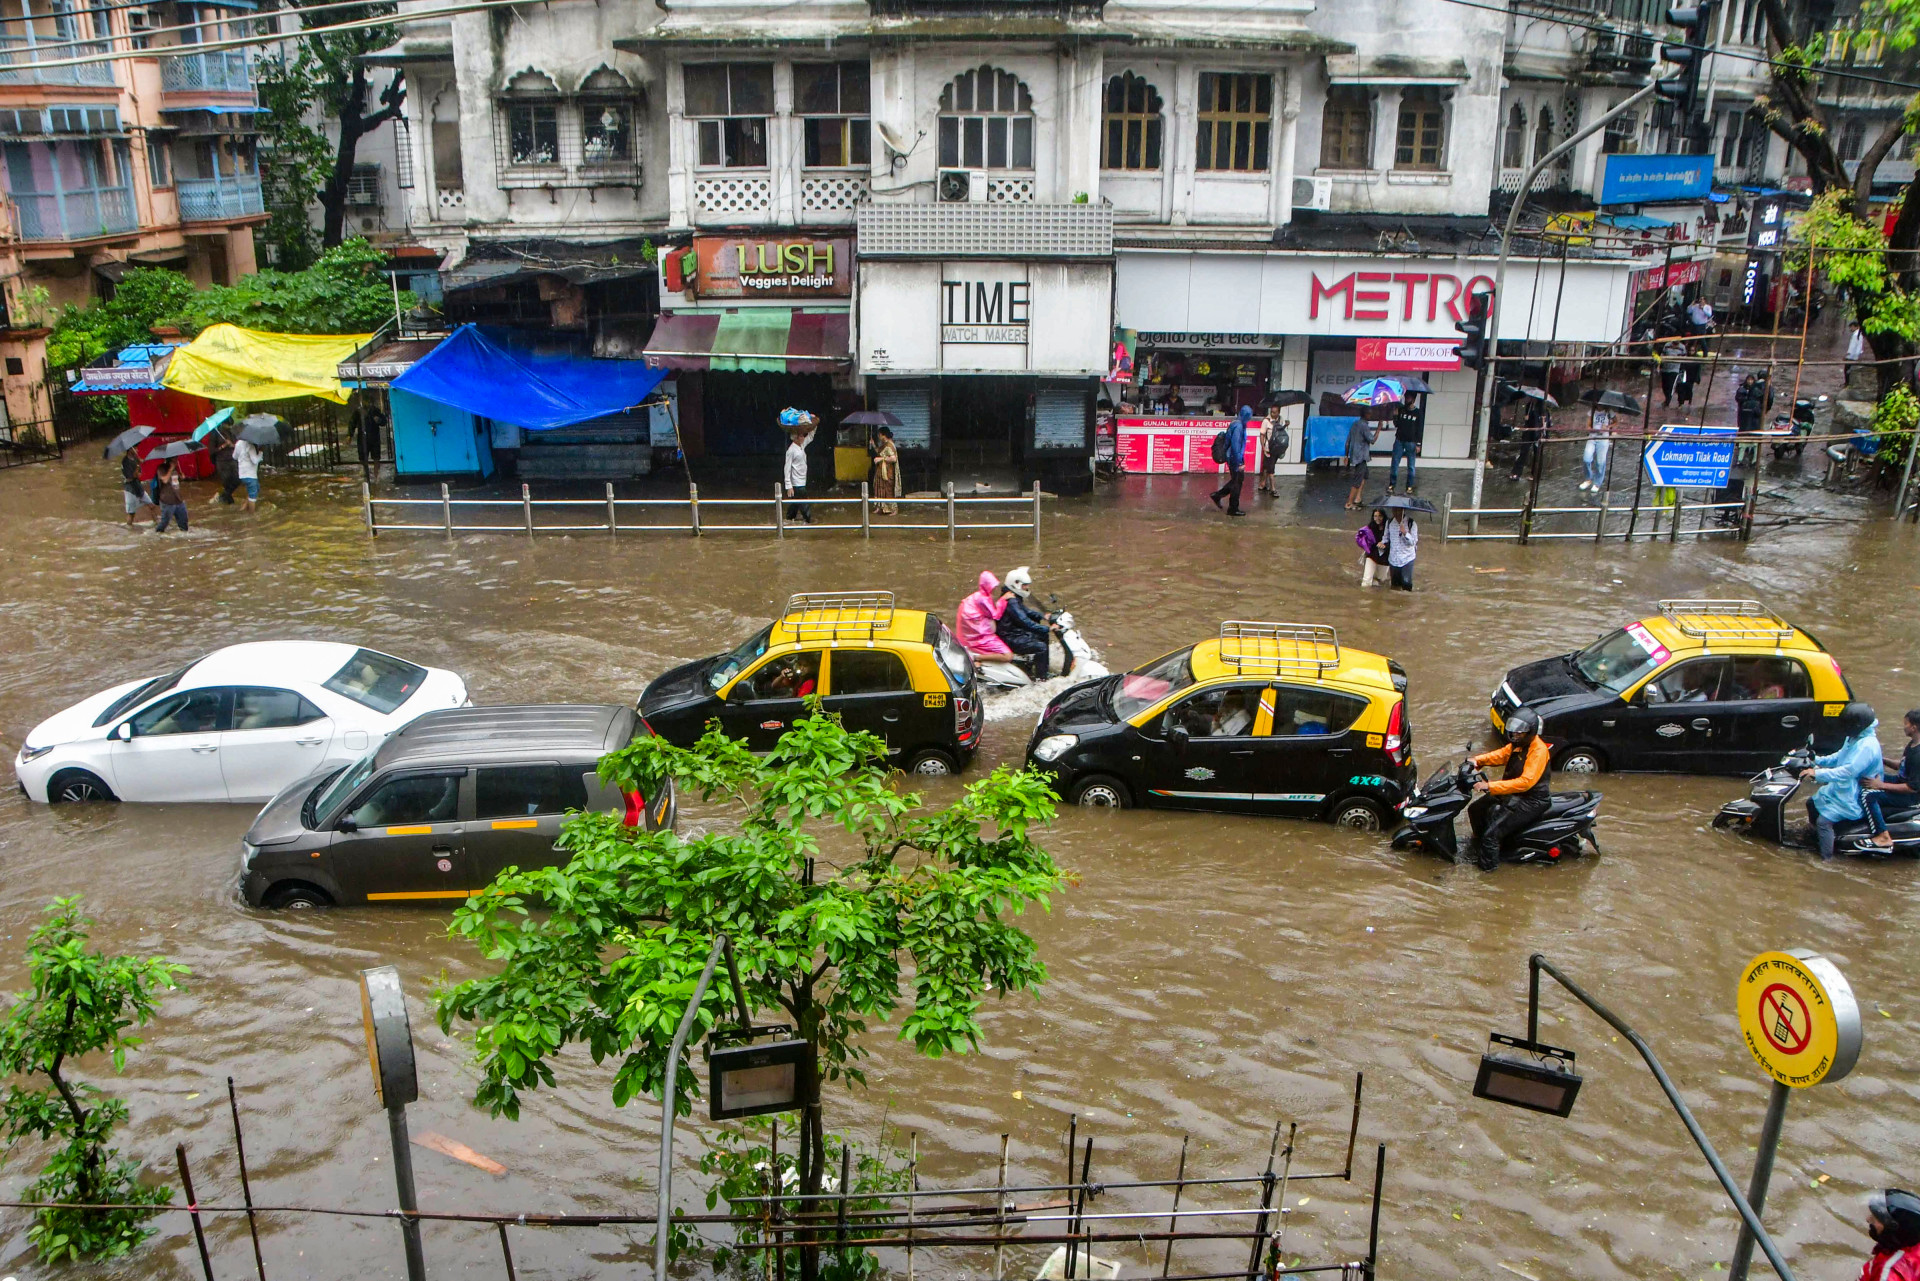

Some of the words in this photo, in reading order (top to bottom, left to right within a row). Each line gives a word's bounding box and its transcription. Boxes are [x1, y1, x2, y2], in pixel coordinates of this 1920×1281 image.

[736, 244, 834, 274] LUSH
[740, 275, 787, 289] Veggies
[791, 275, 834, 288] Delight
[1744, 261, 1758, 303] MOCHI
[942, 281, 1030, 323] TIME
[1311, 272, 1496, 321] METRO
[942, 328, 979, 341] WATCH
[985, 329, 1028, 342] MAKERS
[1360, 342, 1381, 361] Sale
[1389, 347, 1414, 357] FLAT
[1414, 347, 1434, 357] 70%
[1315, 375, 1354, 384] KEEP
[1661, 451, 1694, 463] Lokmanya
[1696, 451, 1711, 462] Tilak
[1712, 452, 1730, 463] Road
[1349, 775, 1381, 786] 4X4
[1747, 961, 1769, 984] वाहन
[1770, 960, 1824, 1005] चालवताना
[1789, 1074, 1810, 1084] वापर
